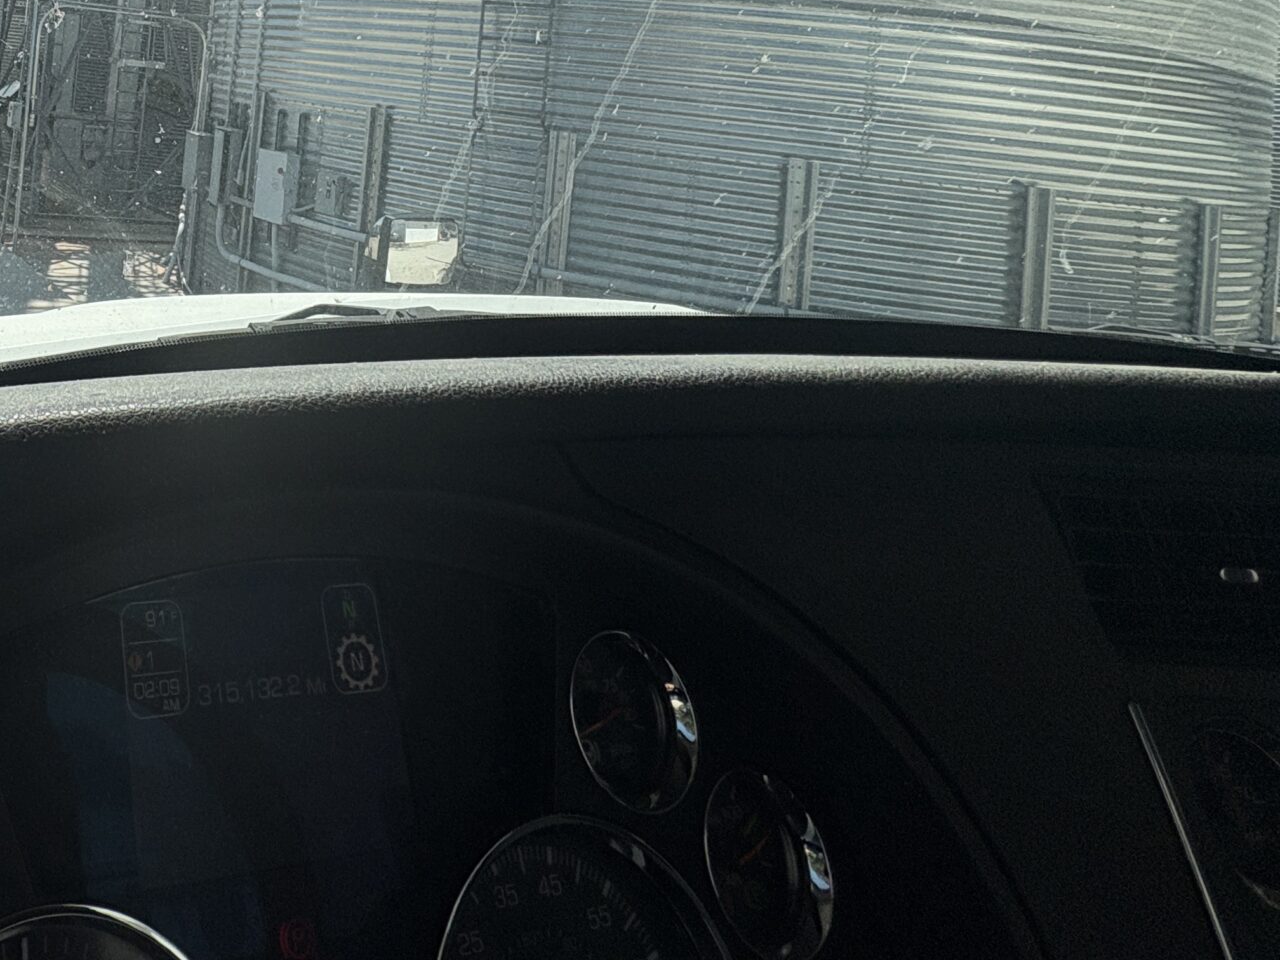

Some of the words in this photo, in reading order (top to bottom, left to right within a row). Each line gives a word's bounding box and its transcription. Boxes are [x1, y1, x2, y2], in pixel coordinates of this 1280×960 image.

[341, 600, 357, 619] N
[349, 651, 365, 672] N
[493, 882, 520, 910] 35
[537, 872, 563, 898] 45
[586, 904, 612, 930] 55
[456, 929, 485, 957] 25
